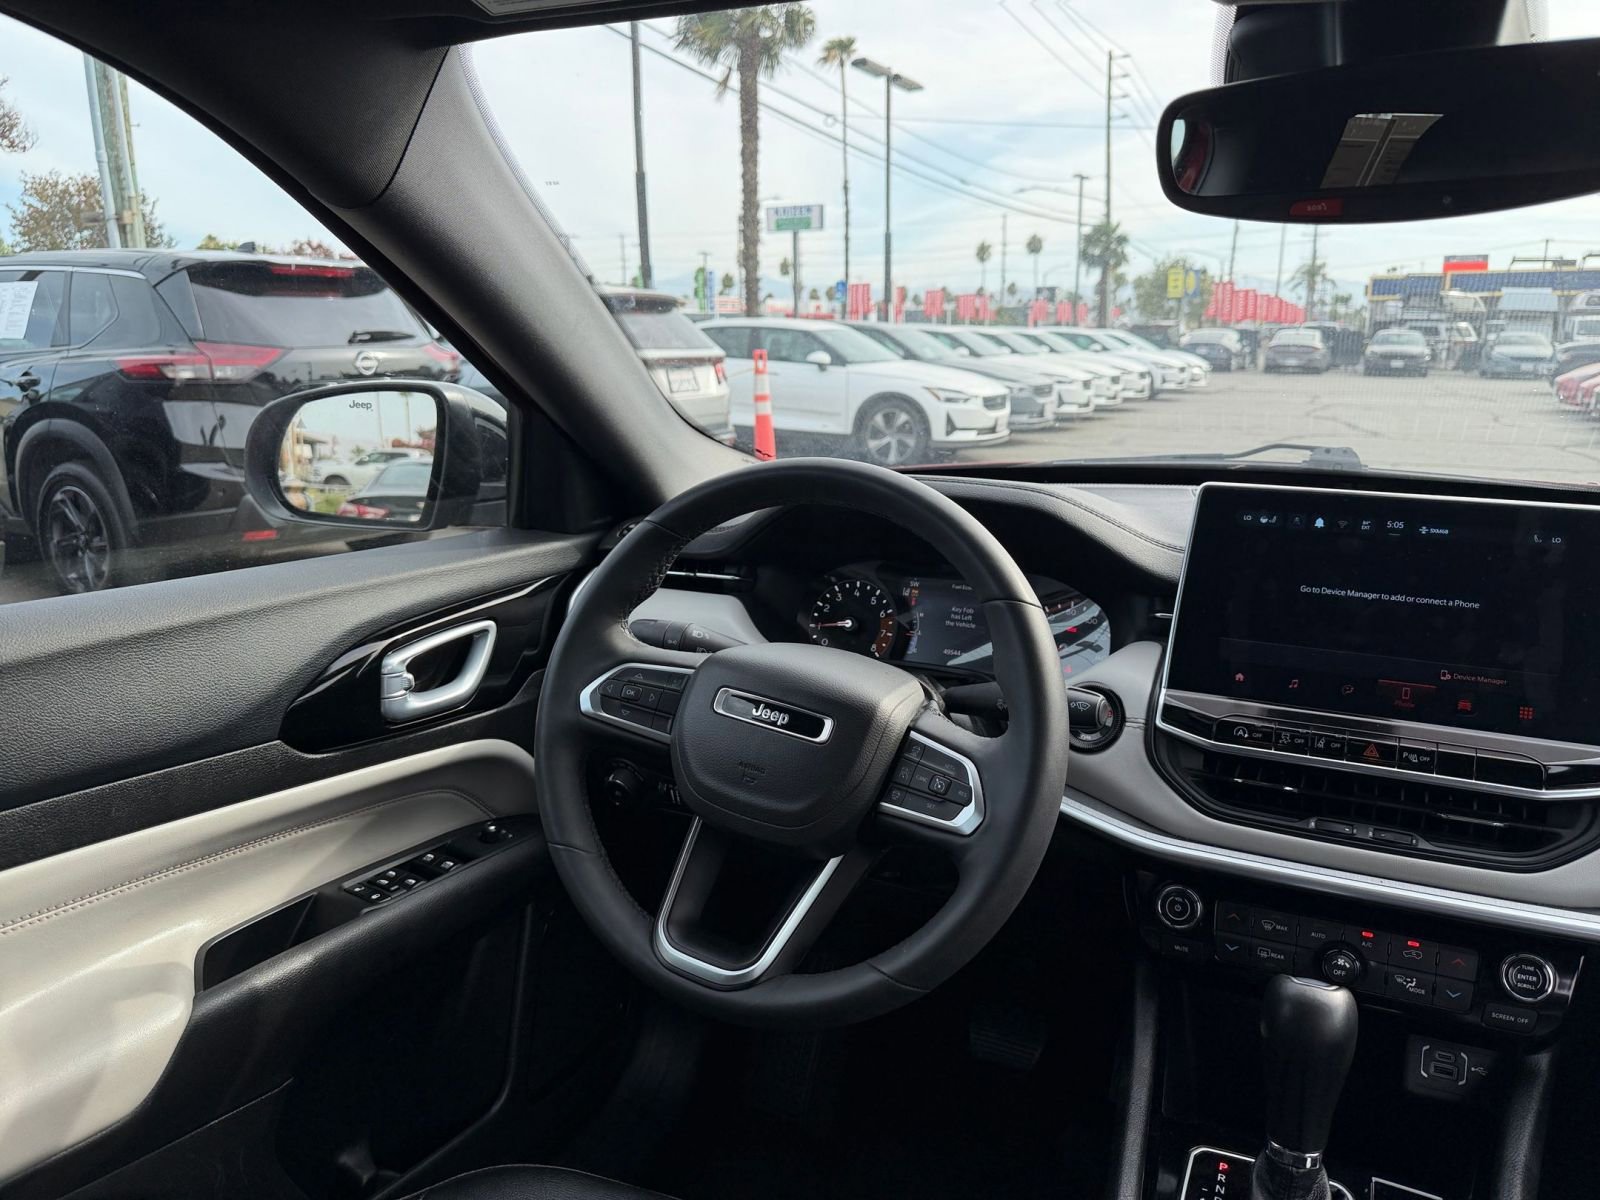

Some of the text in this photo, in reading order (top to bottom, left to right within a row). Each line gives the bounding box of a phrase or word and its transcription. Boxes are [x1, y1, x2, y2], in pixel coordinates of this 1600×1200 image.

[348, 400, 372, 410] Jeep
[1386, 520, 1404, 529] 5:05
[836, 593, 842, 601] 3
[870, 597, 877, 605] 5
[1300, 585, 1311, 593] Go
[1321, 587, 1346, 596] Device
[1347, 590, 1380, 600] Manager
[1390, 594, 1405, 602] add
[1416, 597, 1447, 606] connect
[1455, 600, 1480, 609] Phone
[823, 604, 830, 612] 2
[870, 644, 877, 652] 8
[1453, 673, 1507, 685] Device Manager
[752, 703, 790, 726] Jeep
[1174, 944, 1189, 952] MUTE
[1333, 968, 1346, 976] OFF
[1517, 974, 1537, 982] ENTER
[1408, 987, 1425, 995] MODE
[1491, 1012, 1515, 1022] SCREEN
[1219, 1162, 1228, 1170] P
[1217, 1173, 1226, 1183] R
[1215, 1184, 1225, 1194] N
